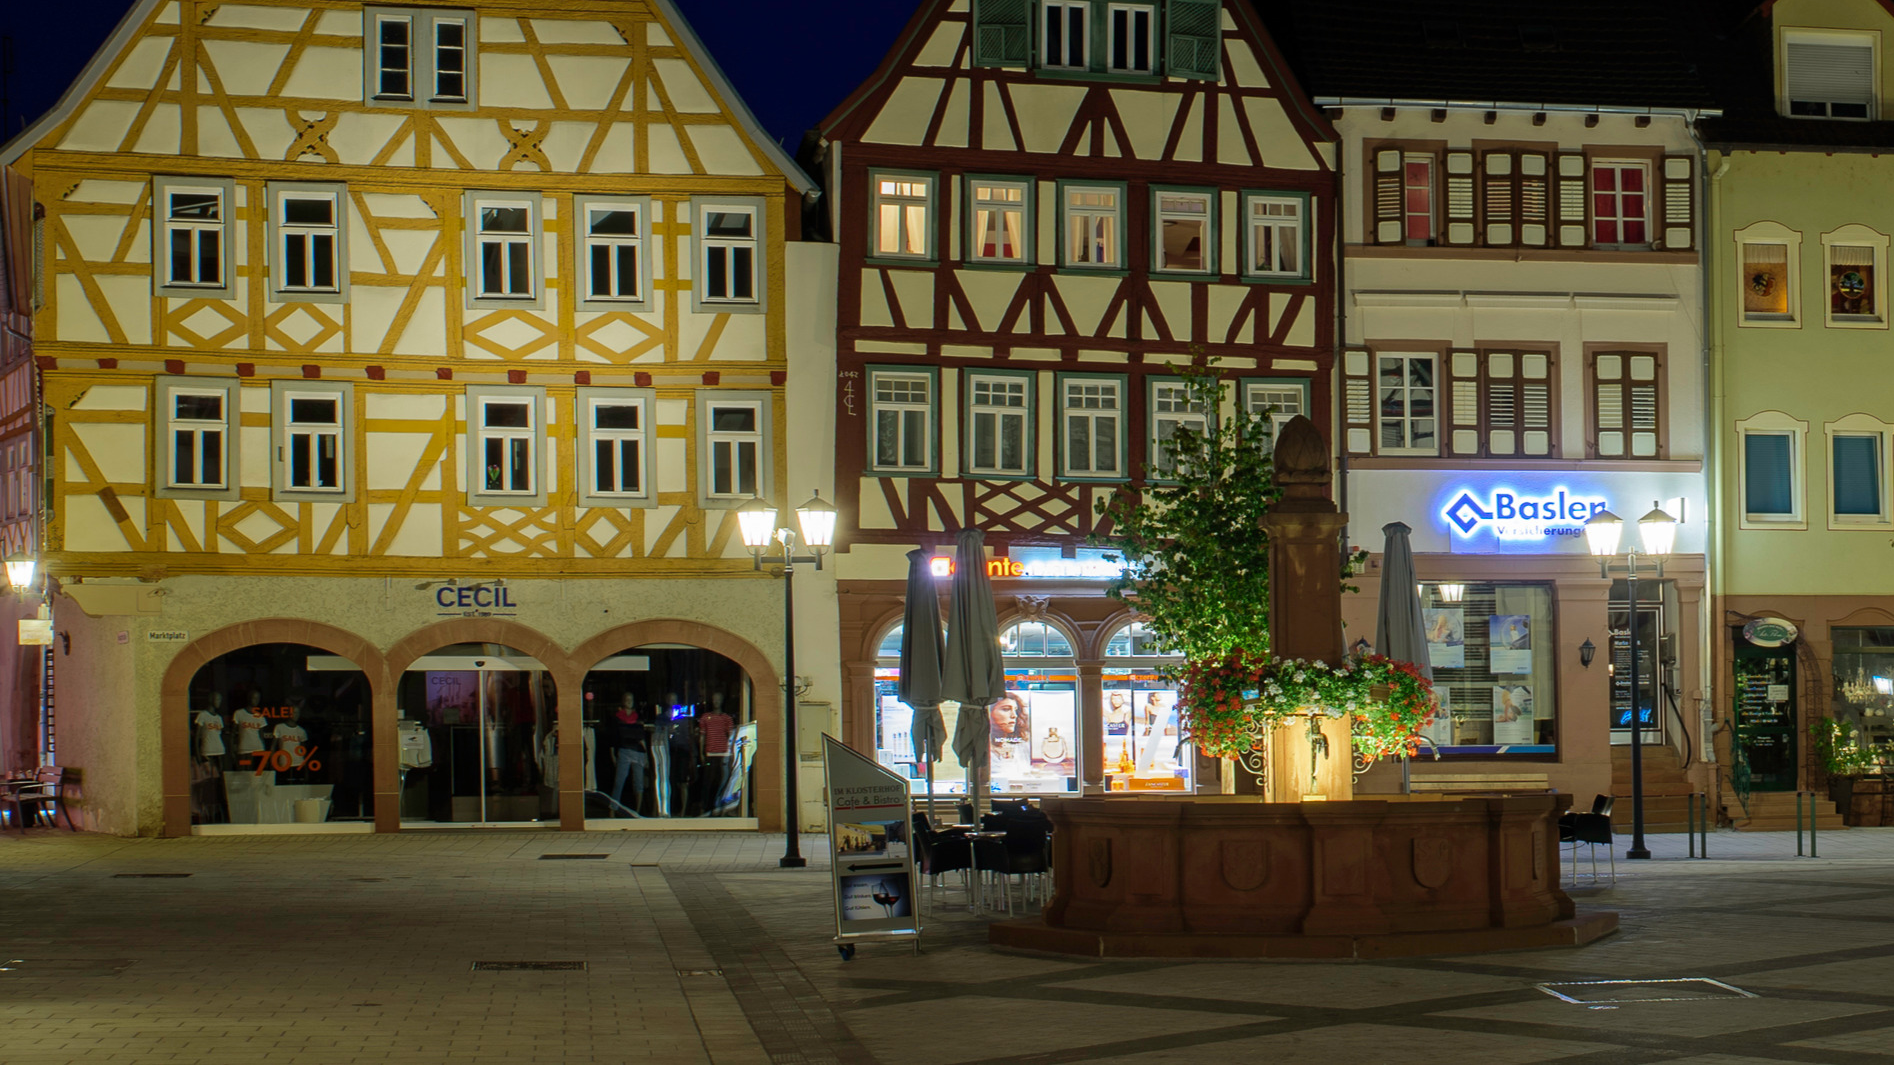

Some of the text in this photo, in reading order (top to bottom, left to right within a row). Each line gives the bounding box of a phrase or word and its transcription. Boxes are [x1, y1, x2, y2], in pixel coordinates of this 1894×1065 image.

[1496, 491, 1606, 521] Basler
[436, 586, 517, 608] CECIL
[149, 632, 186, 640] Marktplatz
[431, 676, 462, 685] CECIL
[251, 706, 294, 718] SALE!
[239, 745, 322, 776] -70%
[845, 784, 901, 795] KLOSTERHOF
[862, 796, 870, 805] &
[873, 795, 900, 805] Bistro
